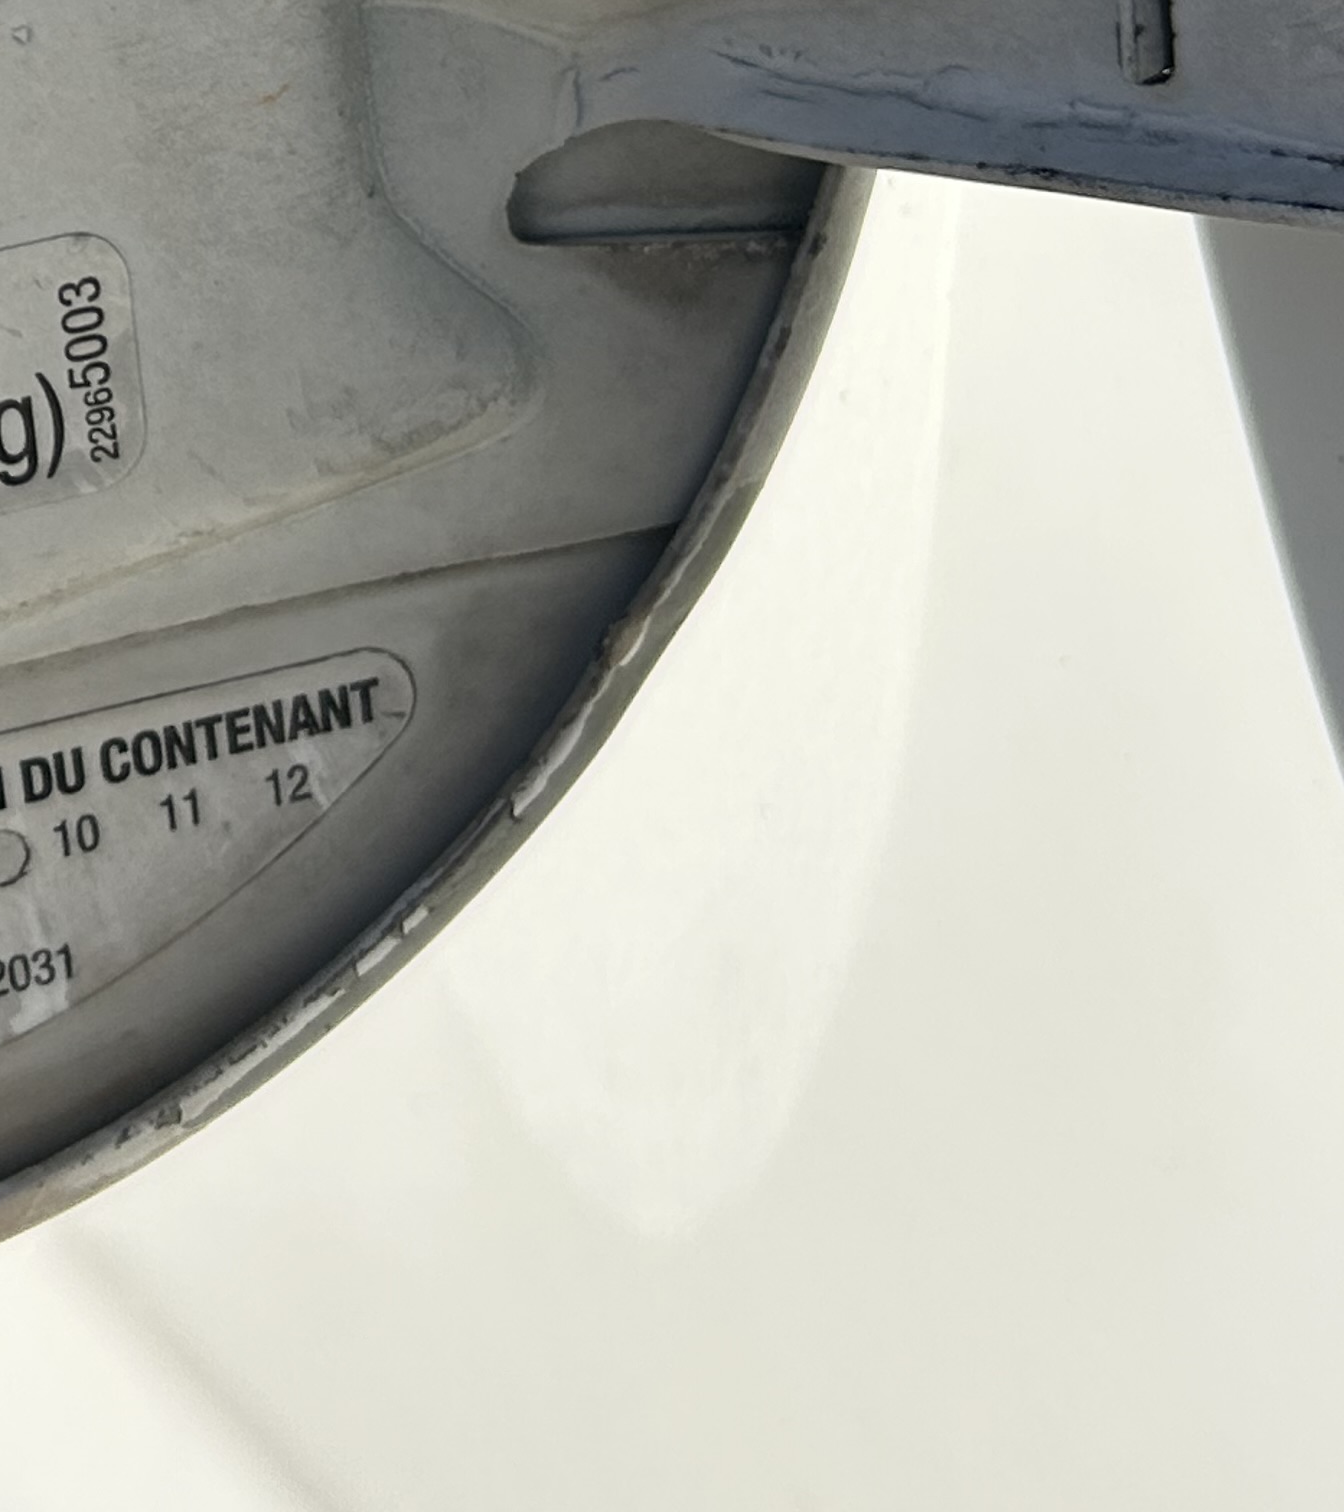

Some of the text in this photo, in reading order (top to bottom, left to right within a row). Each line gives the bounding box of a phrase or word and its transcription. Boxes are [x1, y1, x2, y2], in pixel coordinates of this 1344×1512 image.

[58, 276, 120, 463] 22965003
[20, 747, 85, 804] DU
[100, 678, 379, 784] CONTENANT
[54, 814, 100, 857] 10
[160, 789, 200, 830] 11
[266, 765, 312, 806] 12
